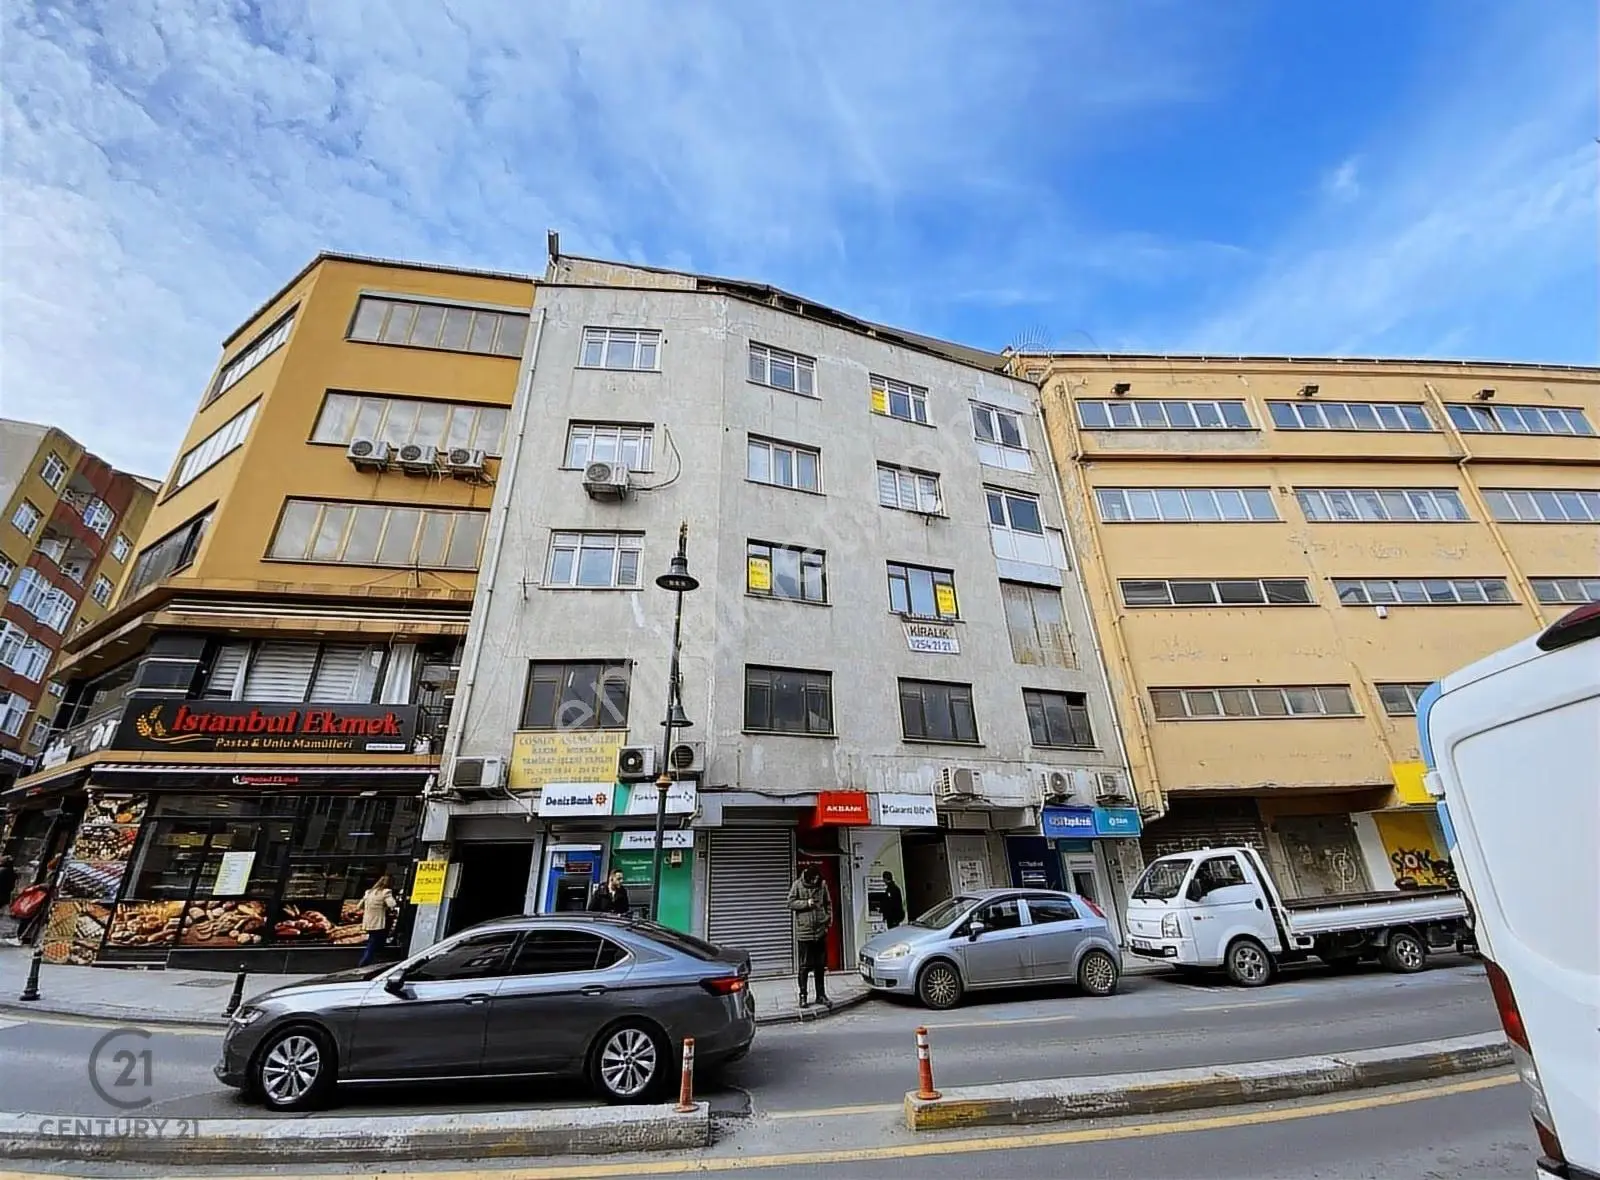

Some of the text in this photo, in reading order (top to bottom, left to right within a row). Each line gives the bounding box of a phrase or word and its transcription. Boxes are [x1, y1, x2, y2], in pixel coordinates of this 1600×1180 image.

[301, 711, 403, 737] Ekmek
[215, 737, 250, 748] Pasta
[262, 738, 291, 748] Unlu
[292, 738, 353, 749] Mamülleri
[545, 795, 594, 806] DenizBank
[826, 805, 863, 813] AKBANK
